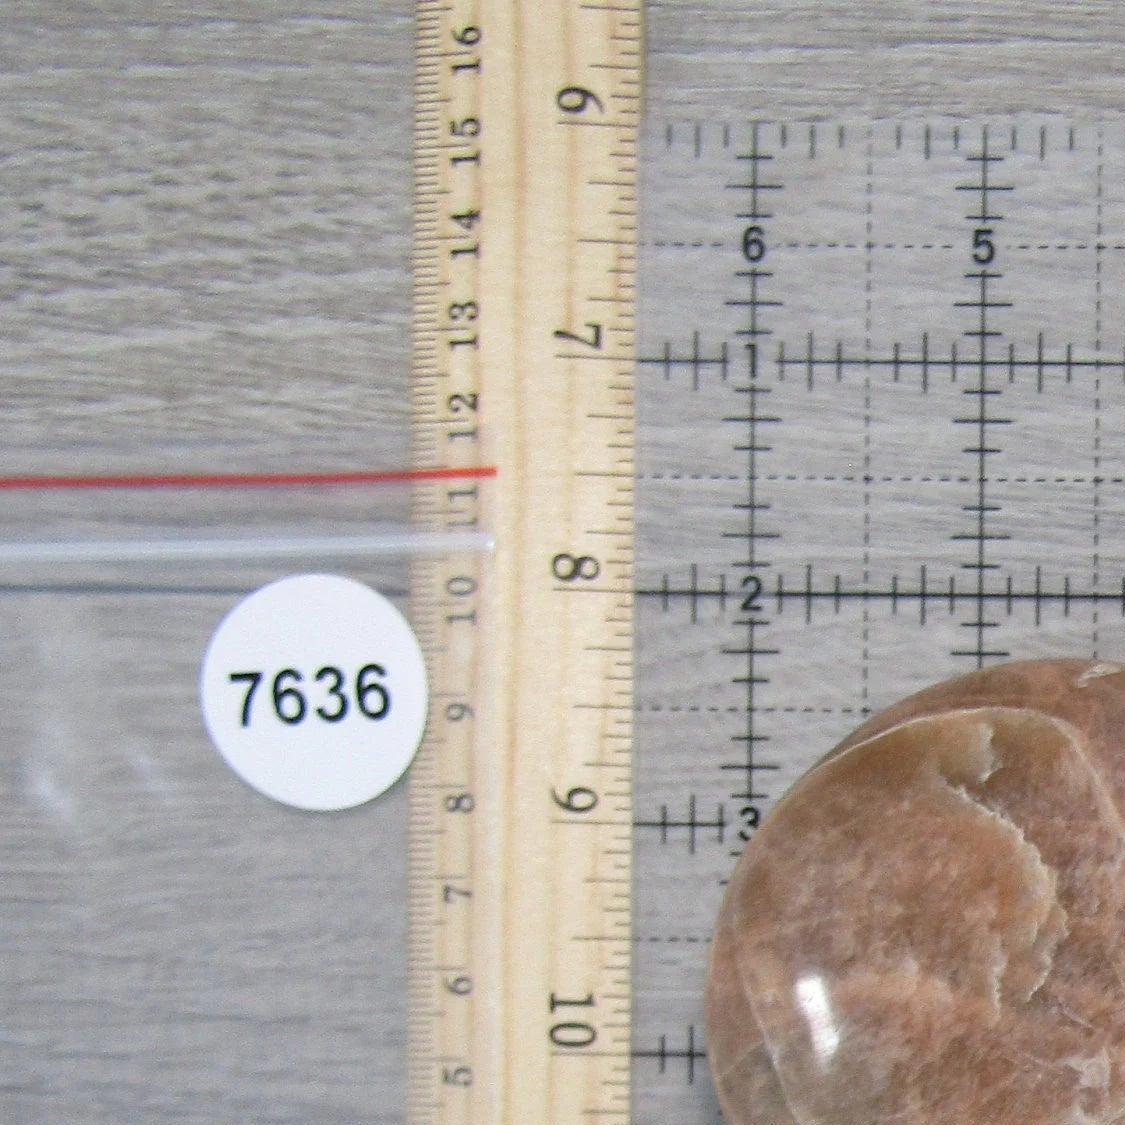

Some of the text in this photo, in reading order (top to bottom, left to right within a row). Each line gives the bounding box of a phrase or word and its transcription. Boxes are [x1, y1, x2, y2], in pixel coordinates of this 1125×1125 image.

[452, 26, 481, 74] 16
[556, 86, 604, 113] 6
[450, 118, 481, 166] 15
[450, 210, 481, 259] 14
[742, 226, 765, 262] 6
[972, 229, 995, 264] 5
[448, 301, 479, 349] 13
[553, 323, 602, 349] 7
[745, 343, 757, 379] 1
[448, 393, 480, 440] 12
[447, 486, 478, 526] 11
[552, 553, 600, 581] 8
[445, 577, 477, 625] 10
[740, 576, 762, 611] 2
[229, 663, 391, 727] 7636
[446, 703, 475, 722] 9
[445, 793, 475, 814] 8
[551, 784, 599, 813] 9
[739, 806, 761, 841] 3
[443, 884, 472, 904] 7
[445, 976, 473, 996] 6
[550, 992, 596, 1047] 10
[442, 1066, 473, 1087] 5
